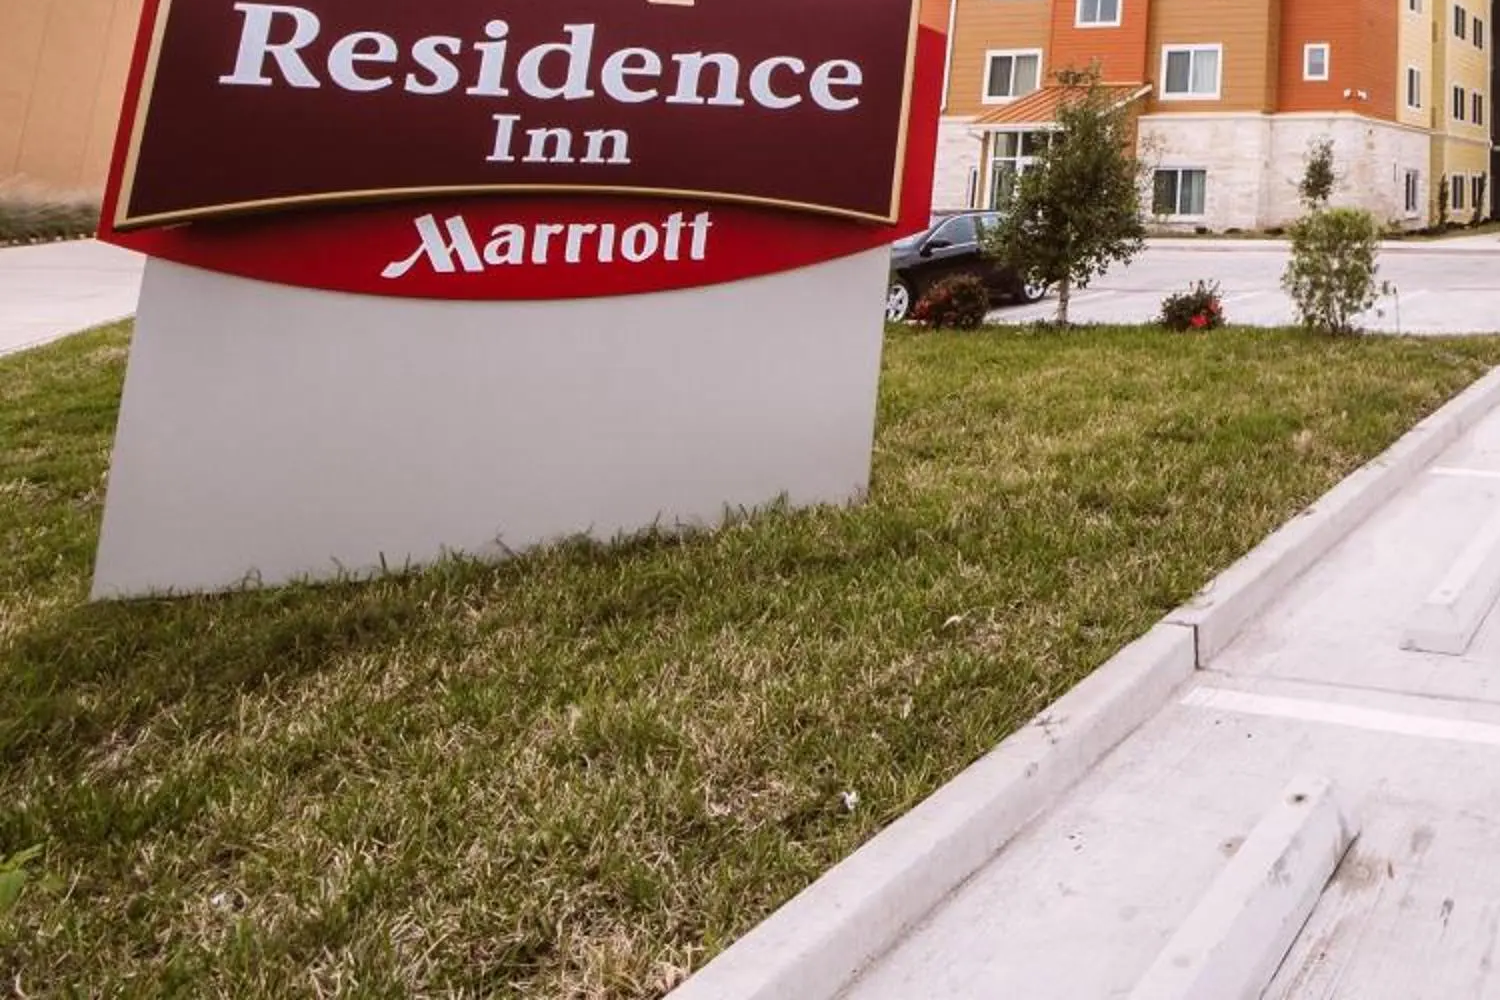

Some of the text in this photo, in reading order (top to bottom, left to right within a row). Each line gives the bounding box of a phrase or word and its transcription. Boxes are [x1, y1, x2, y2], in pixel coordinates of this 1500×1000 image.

[218, 2, 864, 112] Residence
[485, 113, 631, 165] Inn
[380, 211, 713, 279] Marriott
